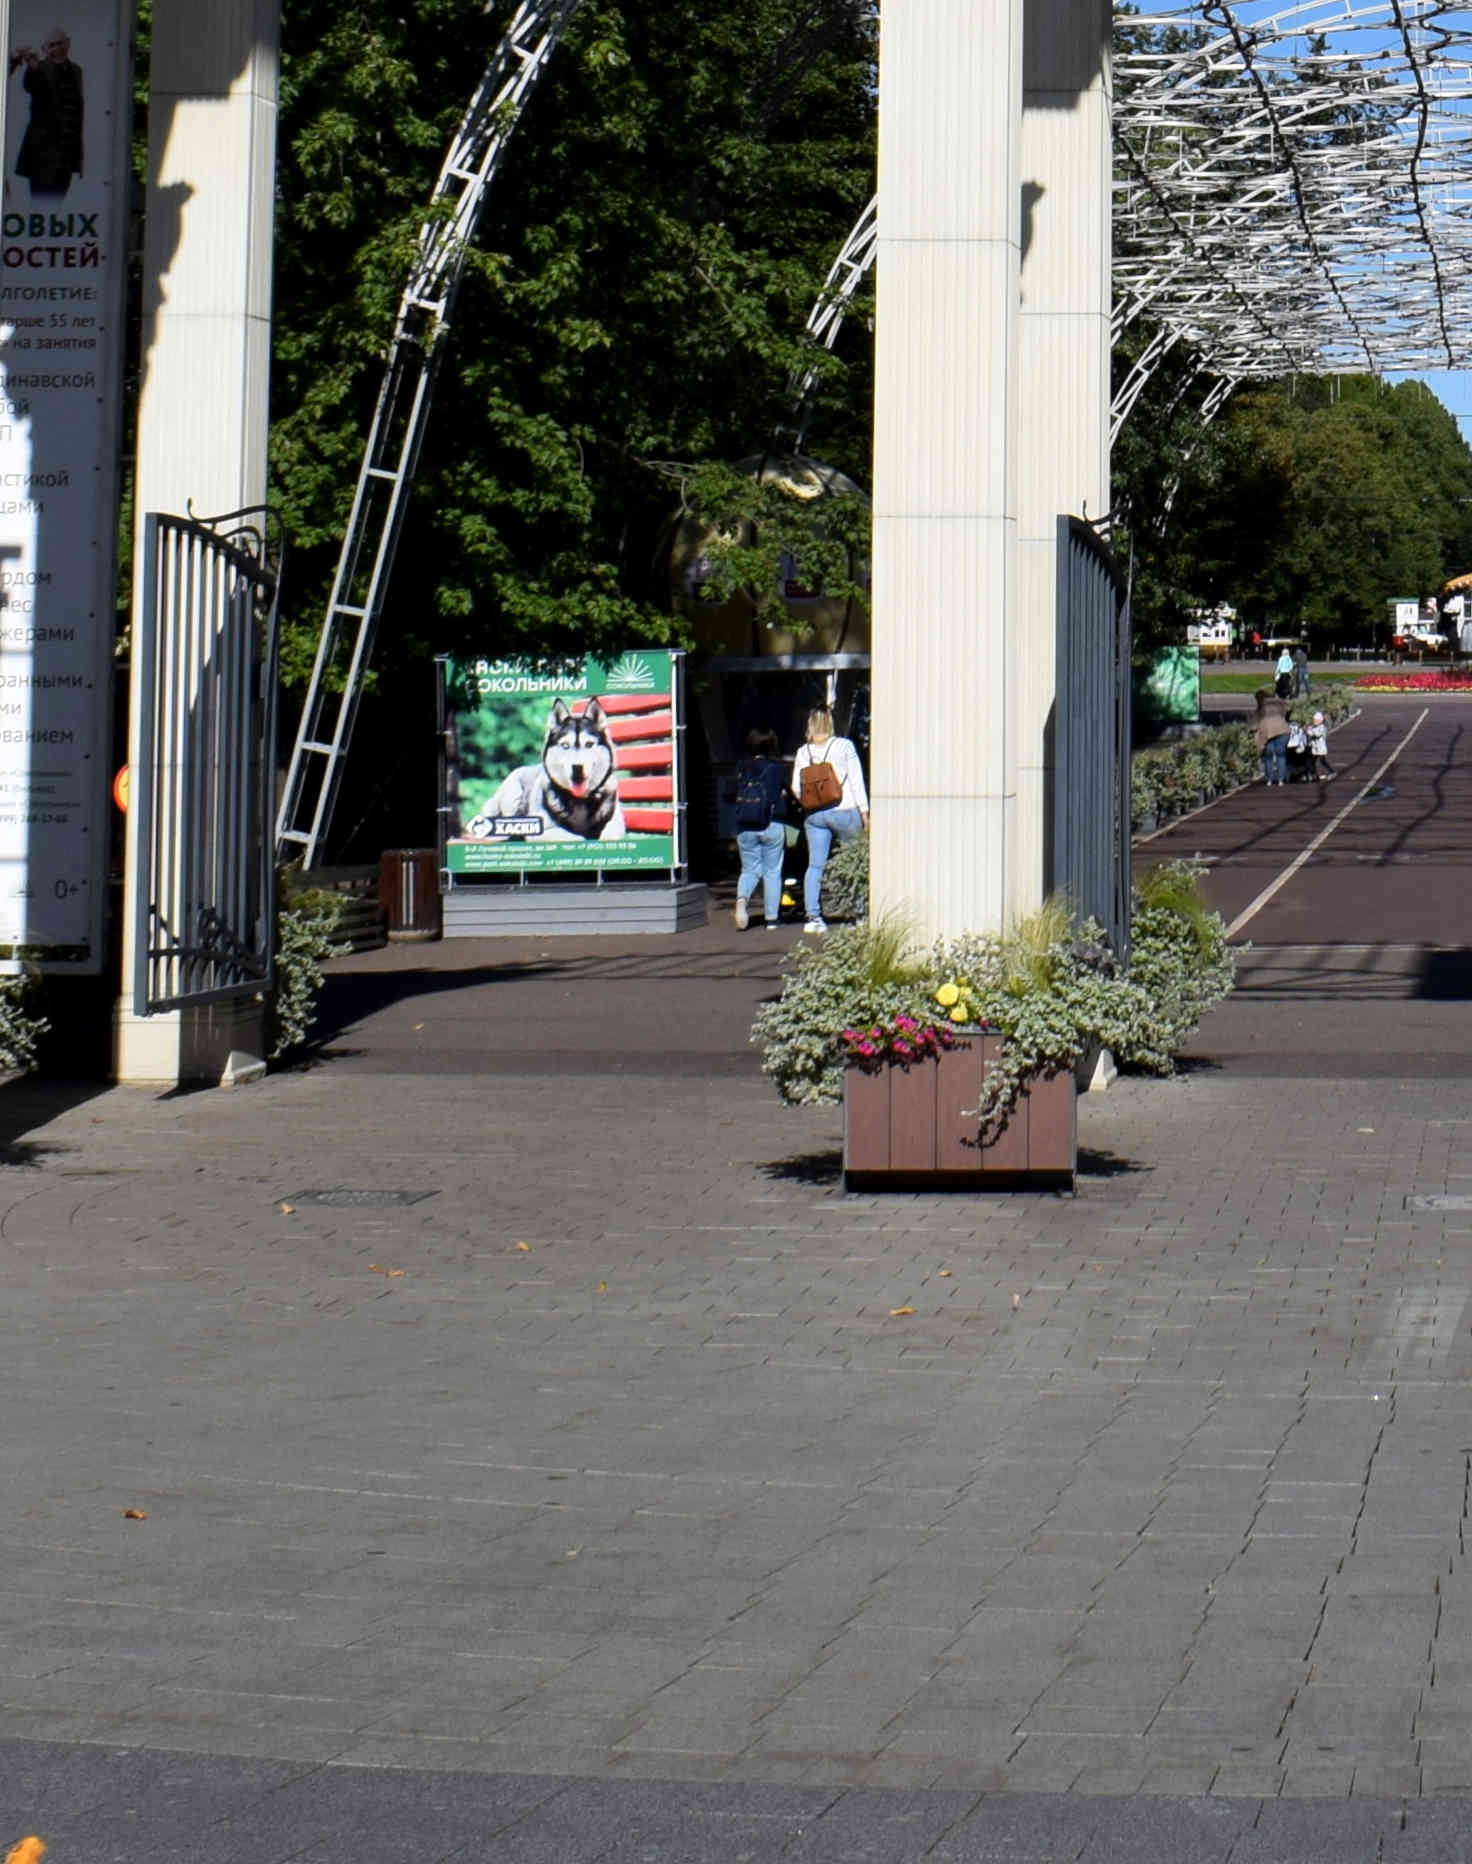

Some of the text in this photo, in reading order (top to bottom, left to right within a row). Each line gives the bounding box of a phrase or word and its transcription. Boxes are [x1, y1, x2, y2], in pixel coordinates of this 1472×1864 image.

[3, 213, 98, 238] ОВЫХ
[3, 242, 99, 268] ОСТЕЙ
[495, 823, 540, 835] ХАСКИ
